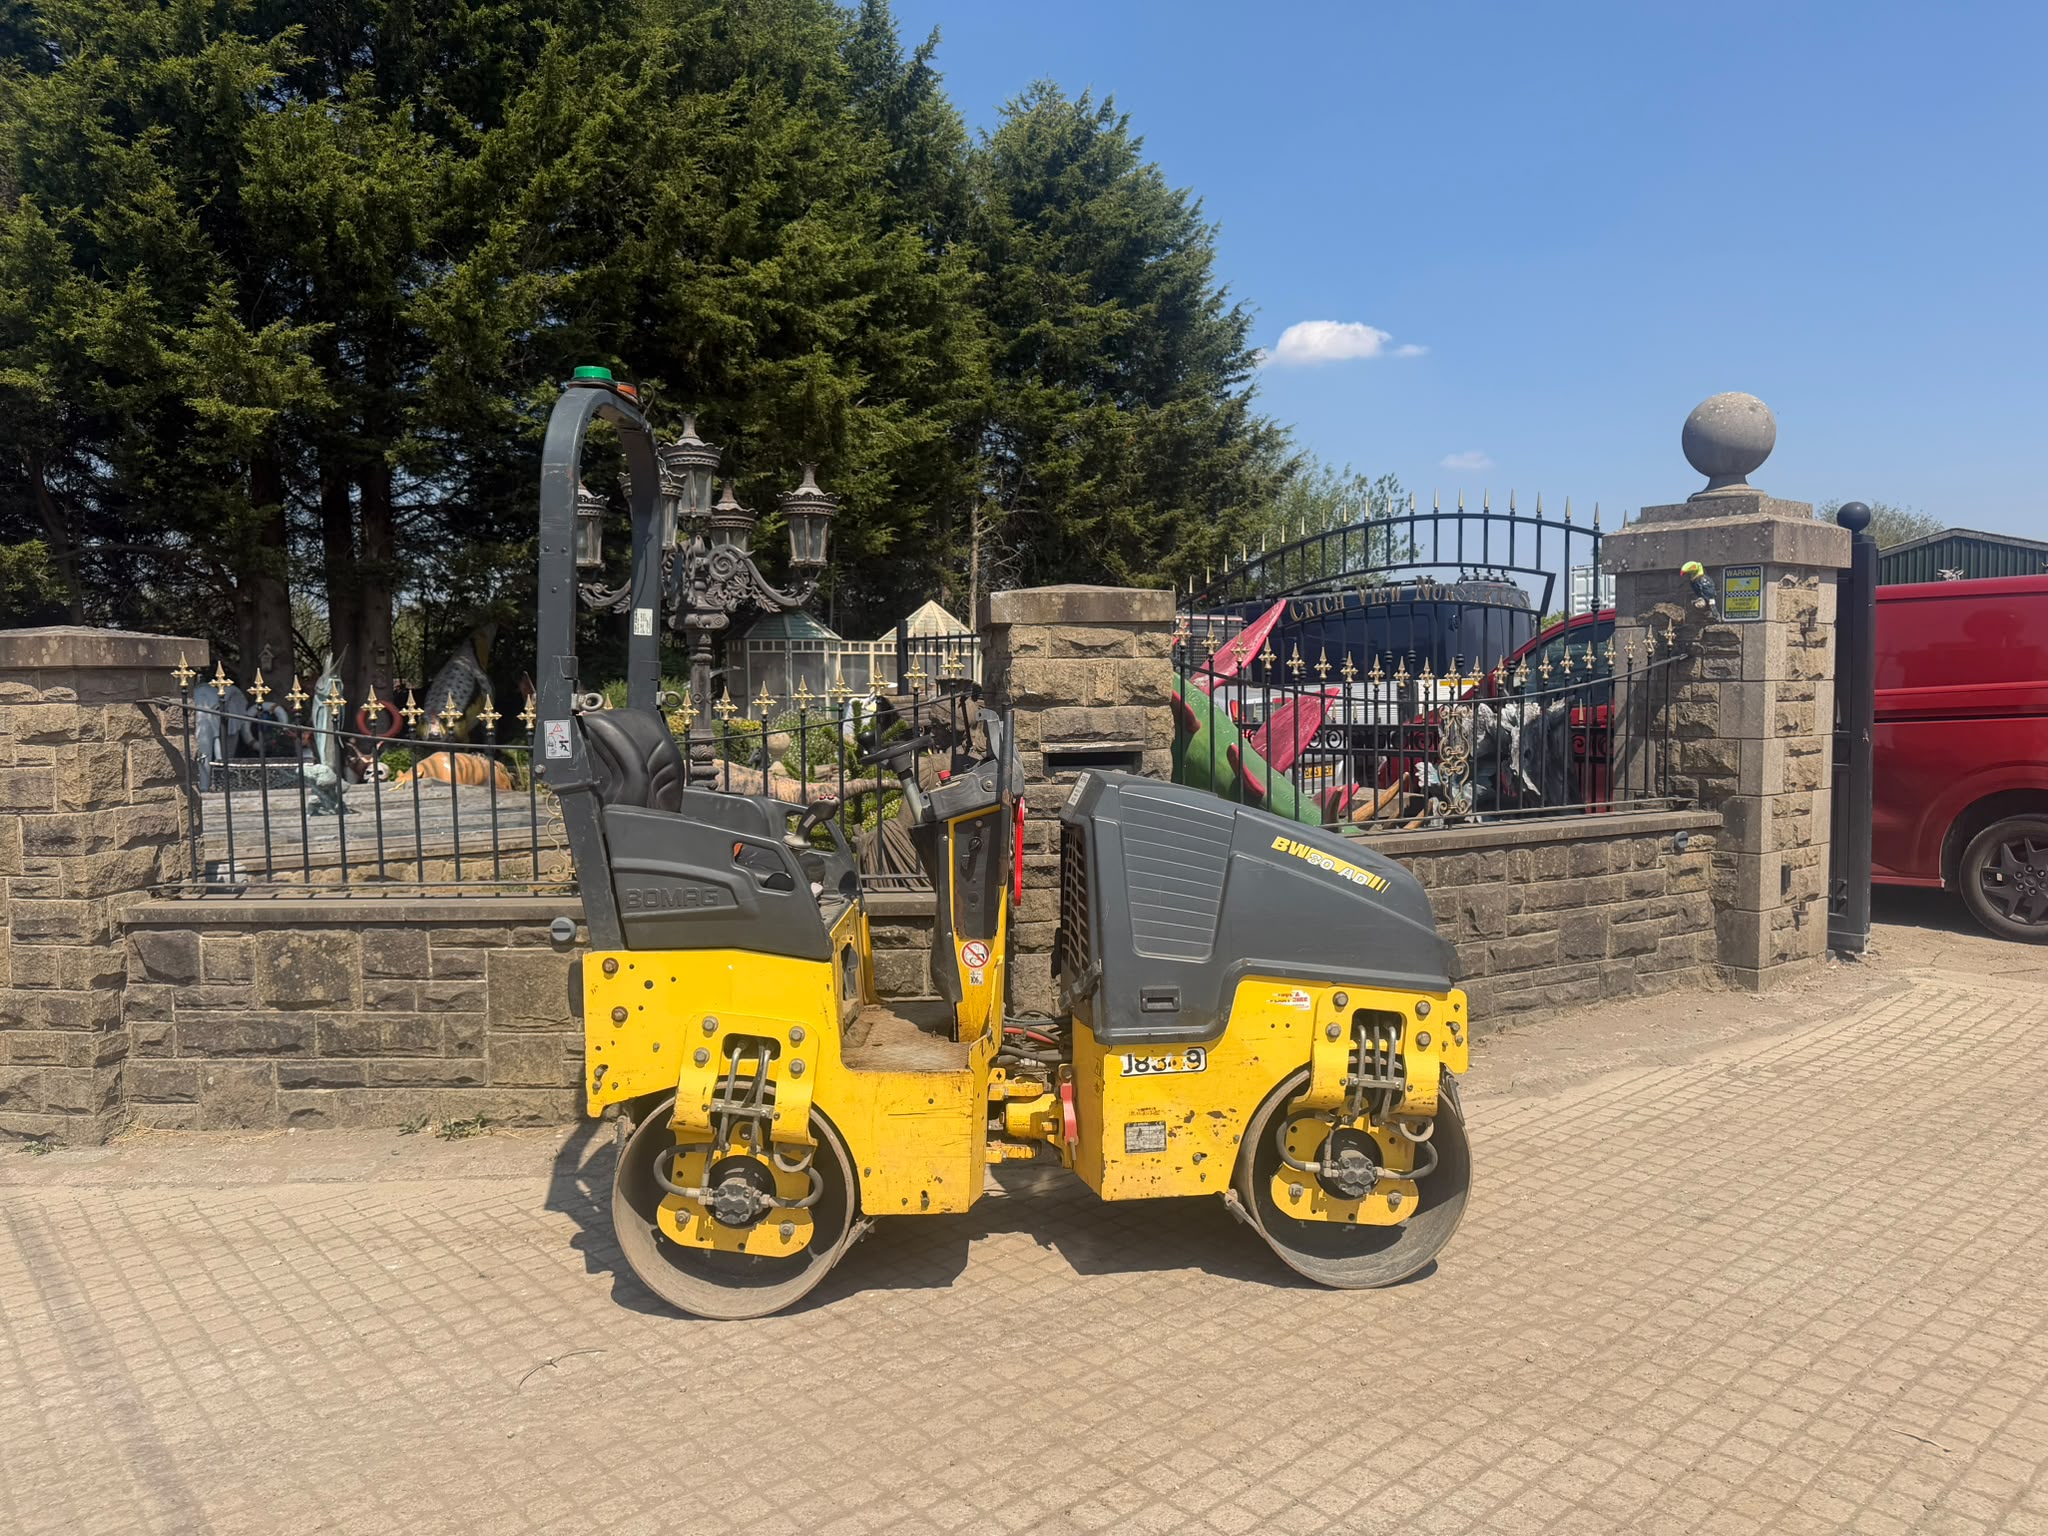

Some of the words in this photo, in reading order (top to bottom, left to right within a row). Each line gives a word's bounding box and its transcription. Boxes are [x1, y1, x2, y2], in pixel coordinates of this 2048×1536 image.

[1726, 568, 1760, 577] WARNING
[1290, 591, 1345, 621] CRICH
[1355, 580, 1402, 606] VIEW
[1337, 866, 1369, 886] AD
[625, 887, 720, 909] BOMAG
